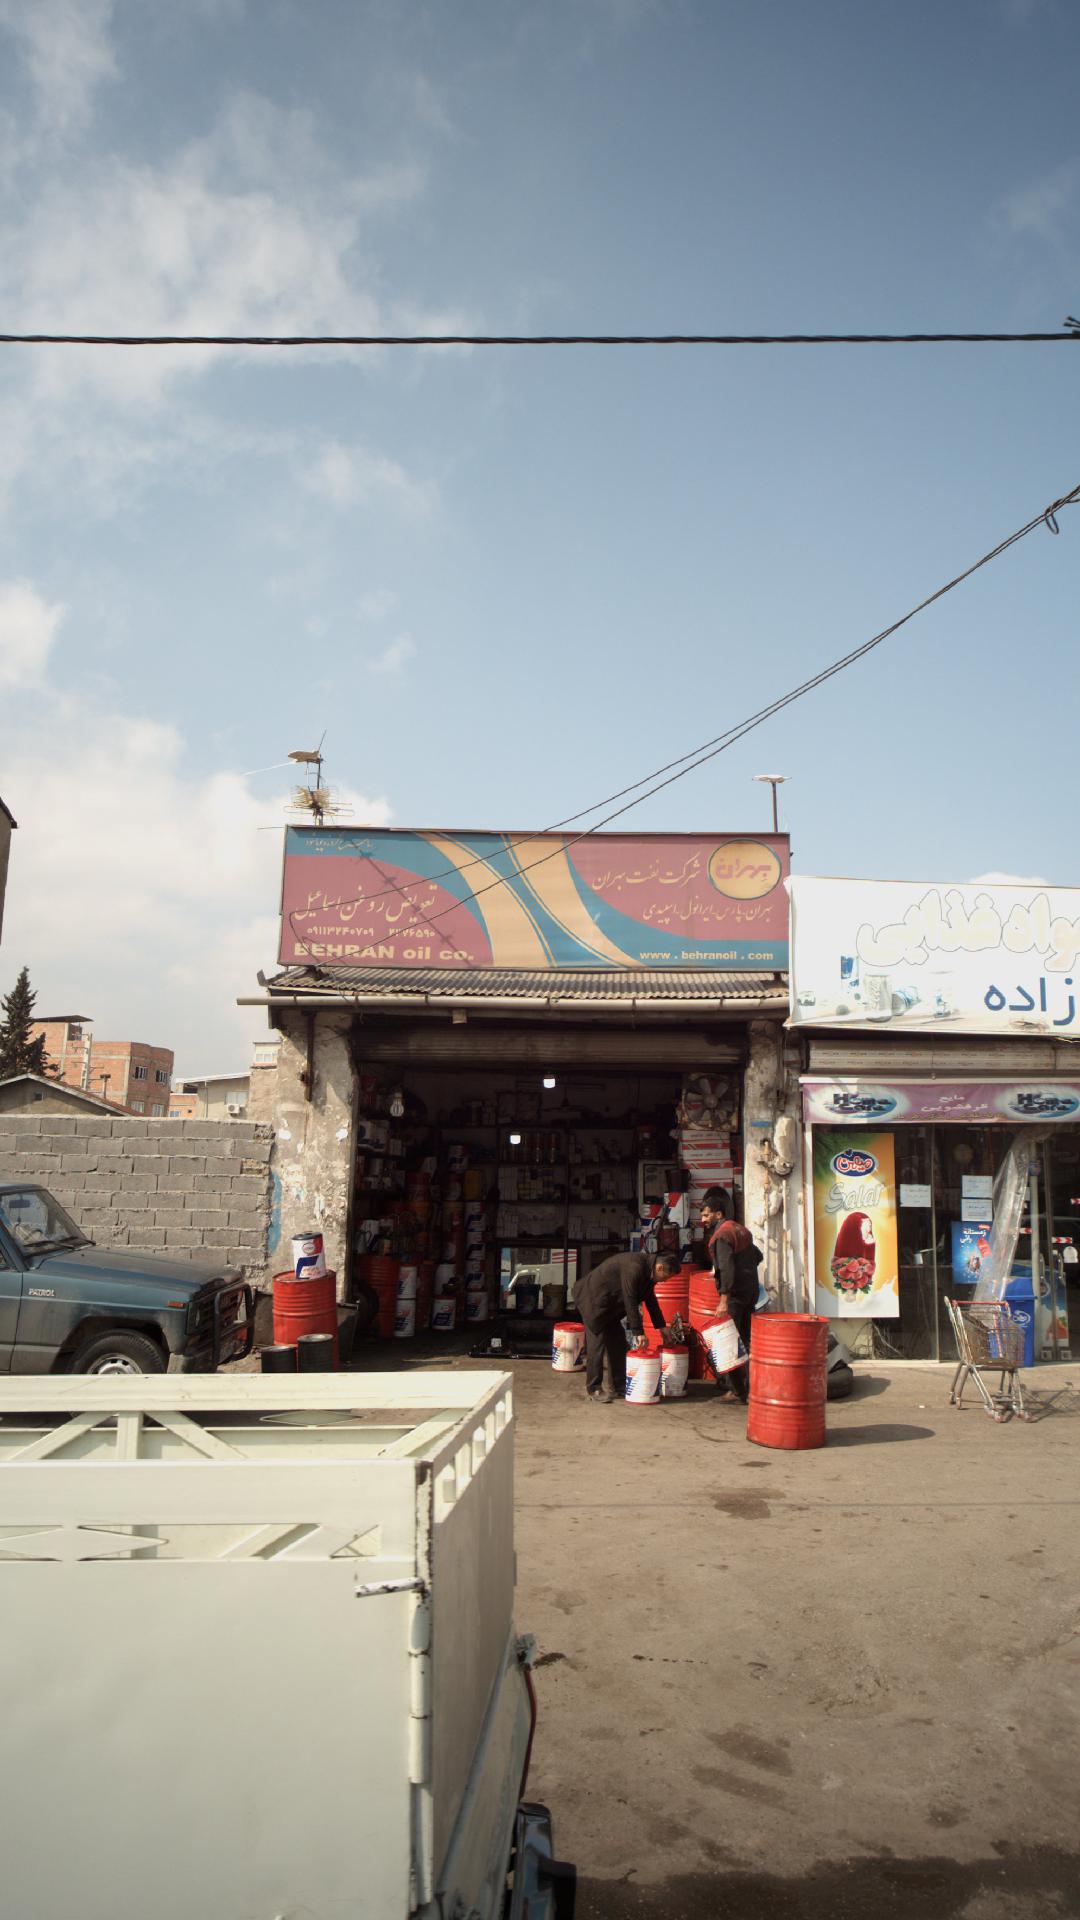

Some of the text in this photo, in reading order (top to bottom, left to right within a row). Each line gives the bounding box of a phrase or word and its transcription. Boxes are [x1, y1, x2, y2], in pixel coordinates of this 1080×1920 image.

[592, 851, 701, 891] شرکت نفت بهران
[340, 885, 385, 921] روغن
[385, 884, 438, 923] تعویض
[294, 943, 394, 958] BEHRAN
[403, 947, 431, 960] oil
[984, 977, 1076, 1026] زاده
[28, 1288, 55, 1297] PATROL
